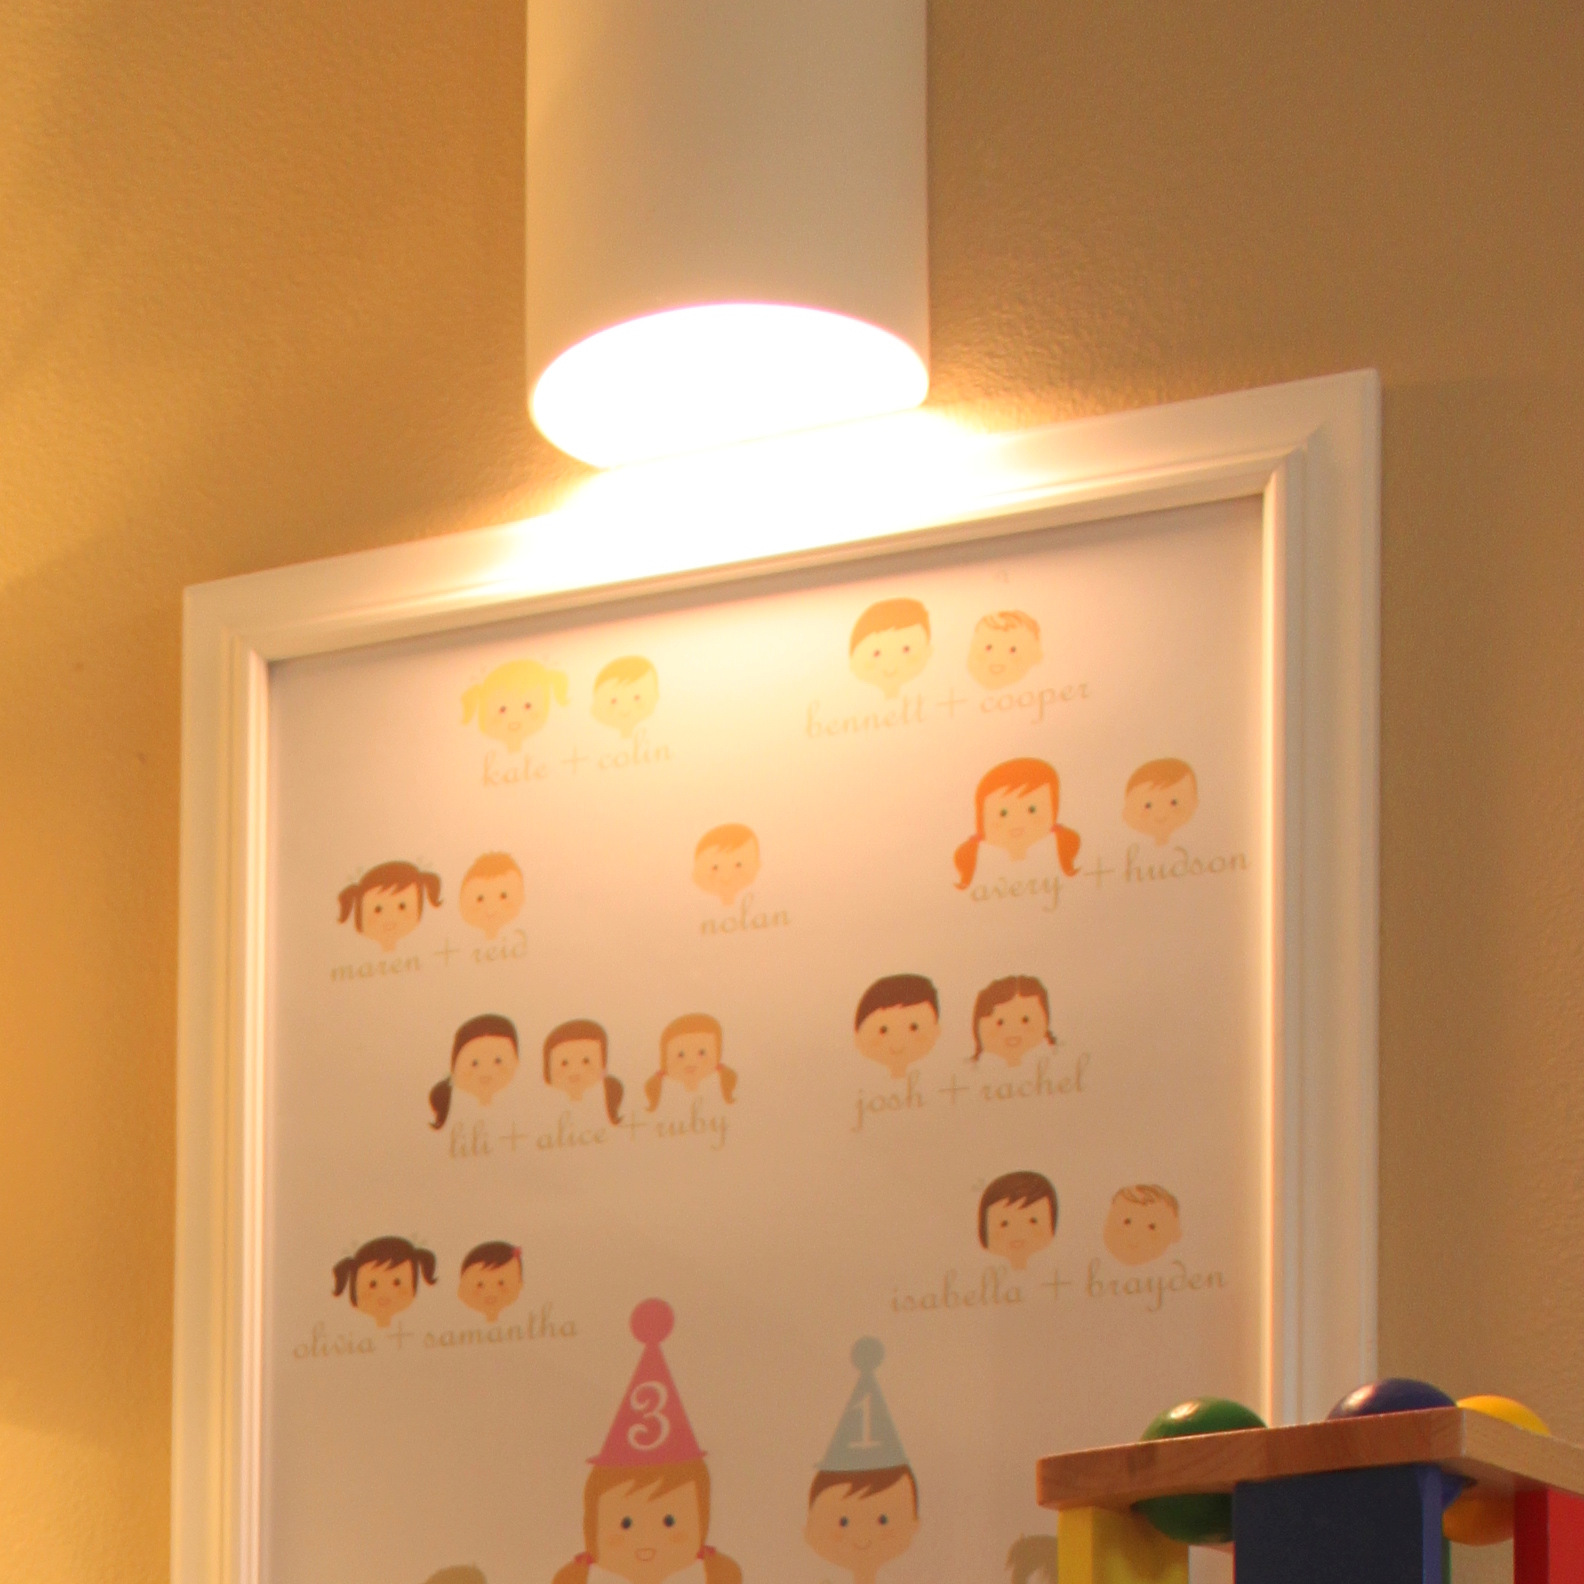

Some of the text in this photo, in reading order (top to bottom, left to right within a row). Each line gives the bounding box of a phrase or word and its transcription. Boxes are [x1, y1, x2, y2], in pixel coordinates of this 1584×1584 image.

[805, 682, 1091, 738] bennett cooper
[482, 732, 672, 786] kate colin
[970, 844, 1249, 913] avery hudson
[700, 895, 791, 935] nolan
[330, 930, 528, 984] maren reid
[850, 1052, 1090, 1133] josh rachel
[448, 1100, 731, 1158] lili alice ruby
[890, 1257, 1227, 1312] isabella brayden
[292, 1306, 578, 1361] olivia samantha
[627, 1380, 671, 1451] 3
[846, 1392, 882, 1450] 1
